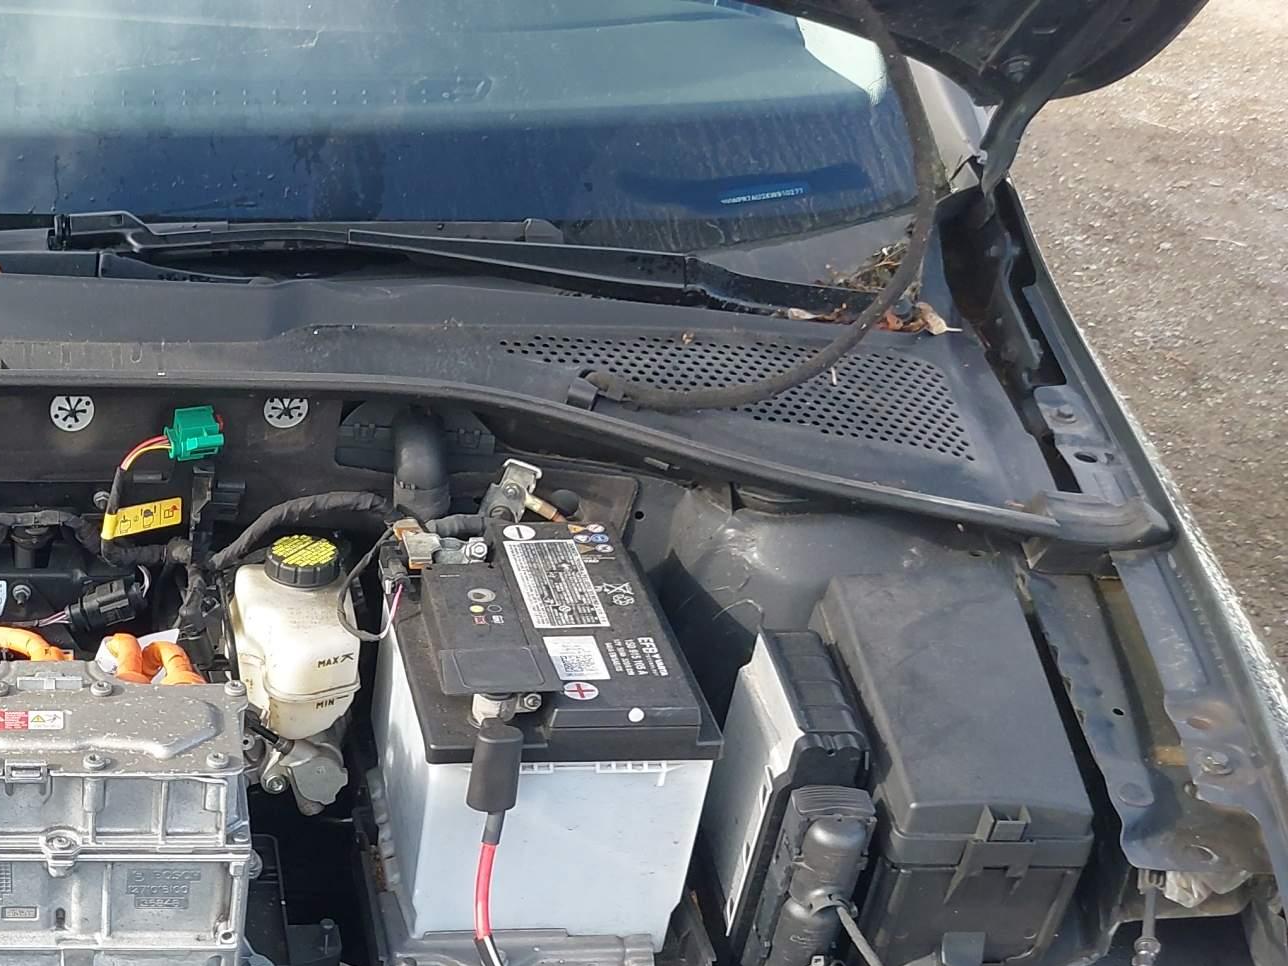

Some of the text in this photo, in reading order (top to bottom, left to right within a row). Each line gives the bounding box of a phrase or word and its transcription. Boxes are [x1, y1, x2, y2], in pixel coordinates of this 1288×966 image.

[637, 637, 658, 654] EFB
[317, 655, 340, 669] MAX
[315, 698, 335, 710] MIN
